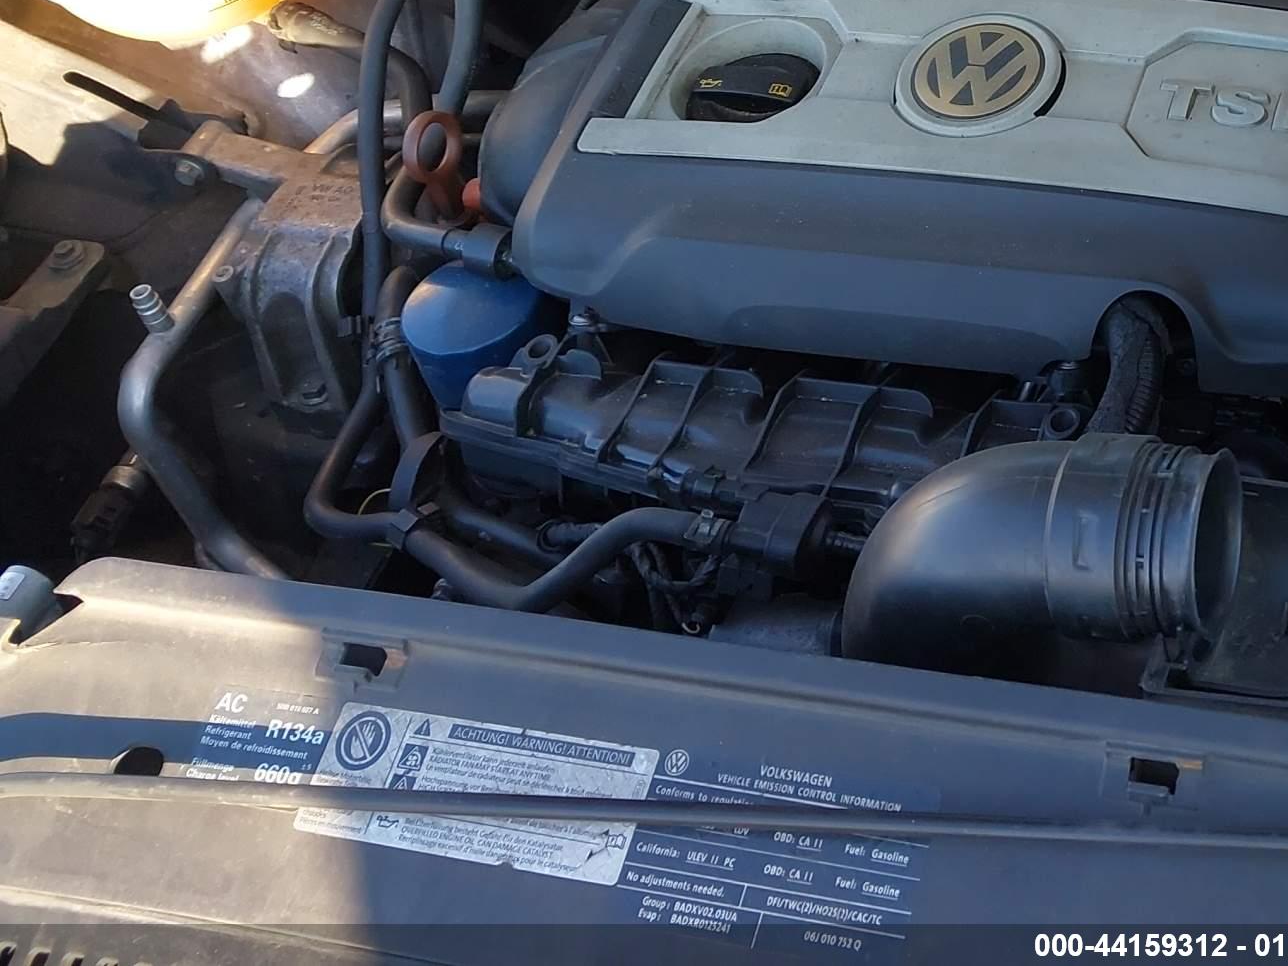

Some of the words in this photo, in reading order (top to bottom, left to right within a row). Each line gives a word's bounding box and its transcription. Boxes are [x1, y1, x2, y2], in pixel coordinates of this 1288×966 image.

[214, 691, 249, 714] AC
[204, 724, 252, 740] Refrigerant
[265, 718, 325, 746] R134a
[200, 735, 229, 749] Moyen
[230, 740, 243, 750] de
[242, 743, 308, 761] refroidissement
[453, 725, 510, 745] ACHTUNG!
[511, 735, 566, 755] WARNING!
[566, 745, 632, 765] ATTENTION!
[759, 764, 833, 788] VOLKSWAGEN
[655, 784, 695, 800] Conforms
[698, 792, 708, 802] to
[716, 772, 750, 788] VEHICLE
[753, 778, 794, 795] EMISSION
[797, 786, 836, 803] CONTROL
[839, 793, 902, 813] INFORMATION
[773, 831, 795, 844] OBD:
[798, 836, 810, 847] CA
[844, 844, 865, 857] Fuel:
[871, 848, 910, 865] Gasoline
[635, 841, 680, 859] California:
[686, 850, 707, 863] ULEV
[723, 857, 736, 868] PC
[763, 864, 785, 877] OBD:
[788, 868, 801, 880] CA
[835, 877, 856, 890] Fuel:
[862, 881, 900, 898] Gasoline
[626, 871, 639, 882] No
[640, 875, 691, 893] adjustments
[691, 883, 725, 898] needed.
[637, 908, 662, 922] Evap:
[642, 895, 670, 911] Group:
[853, 939, 862, 952] Q
